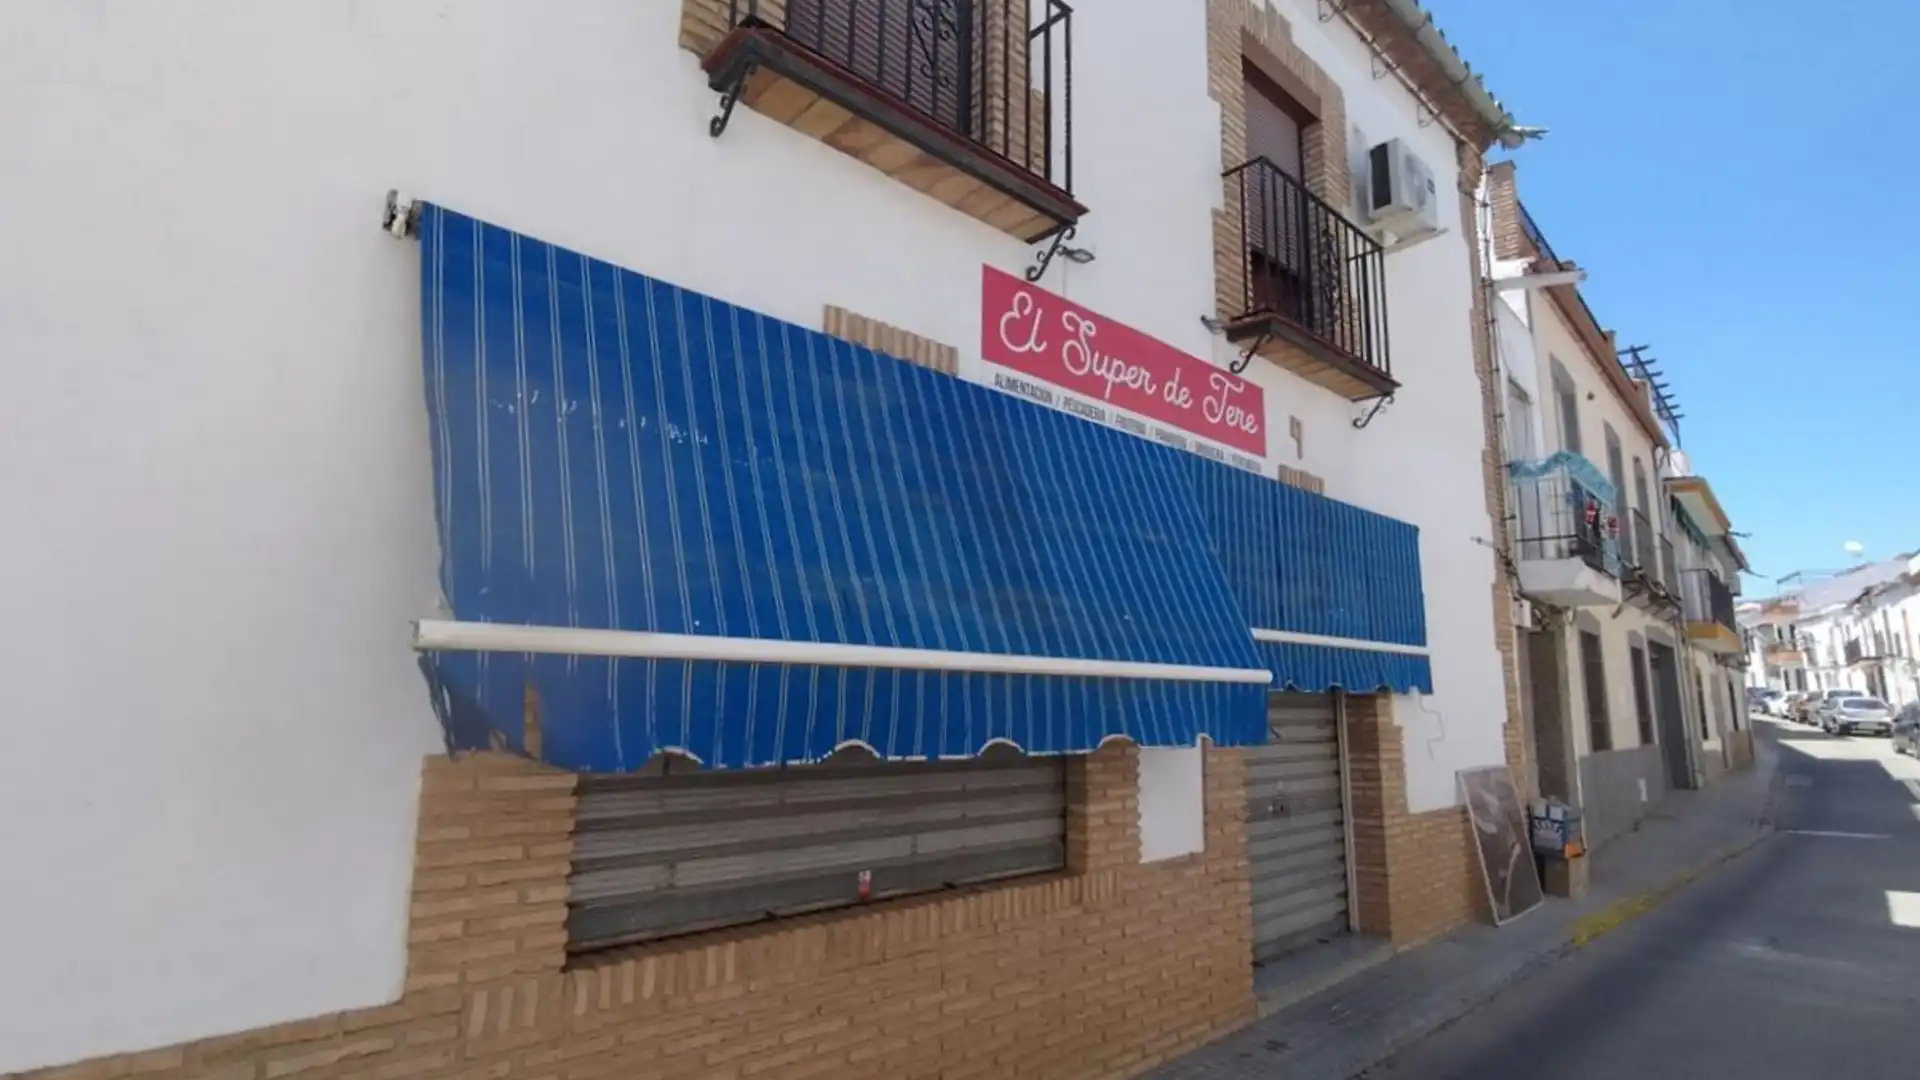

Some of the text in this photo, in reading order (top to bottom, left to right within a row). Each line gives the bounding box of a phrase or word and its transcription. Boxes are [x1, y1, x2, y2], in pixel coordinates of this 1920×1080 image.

[999, 291, 1260, 434] El Super de Tere
